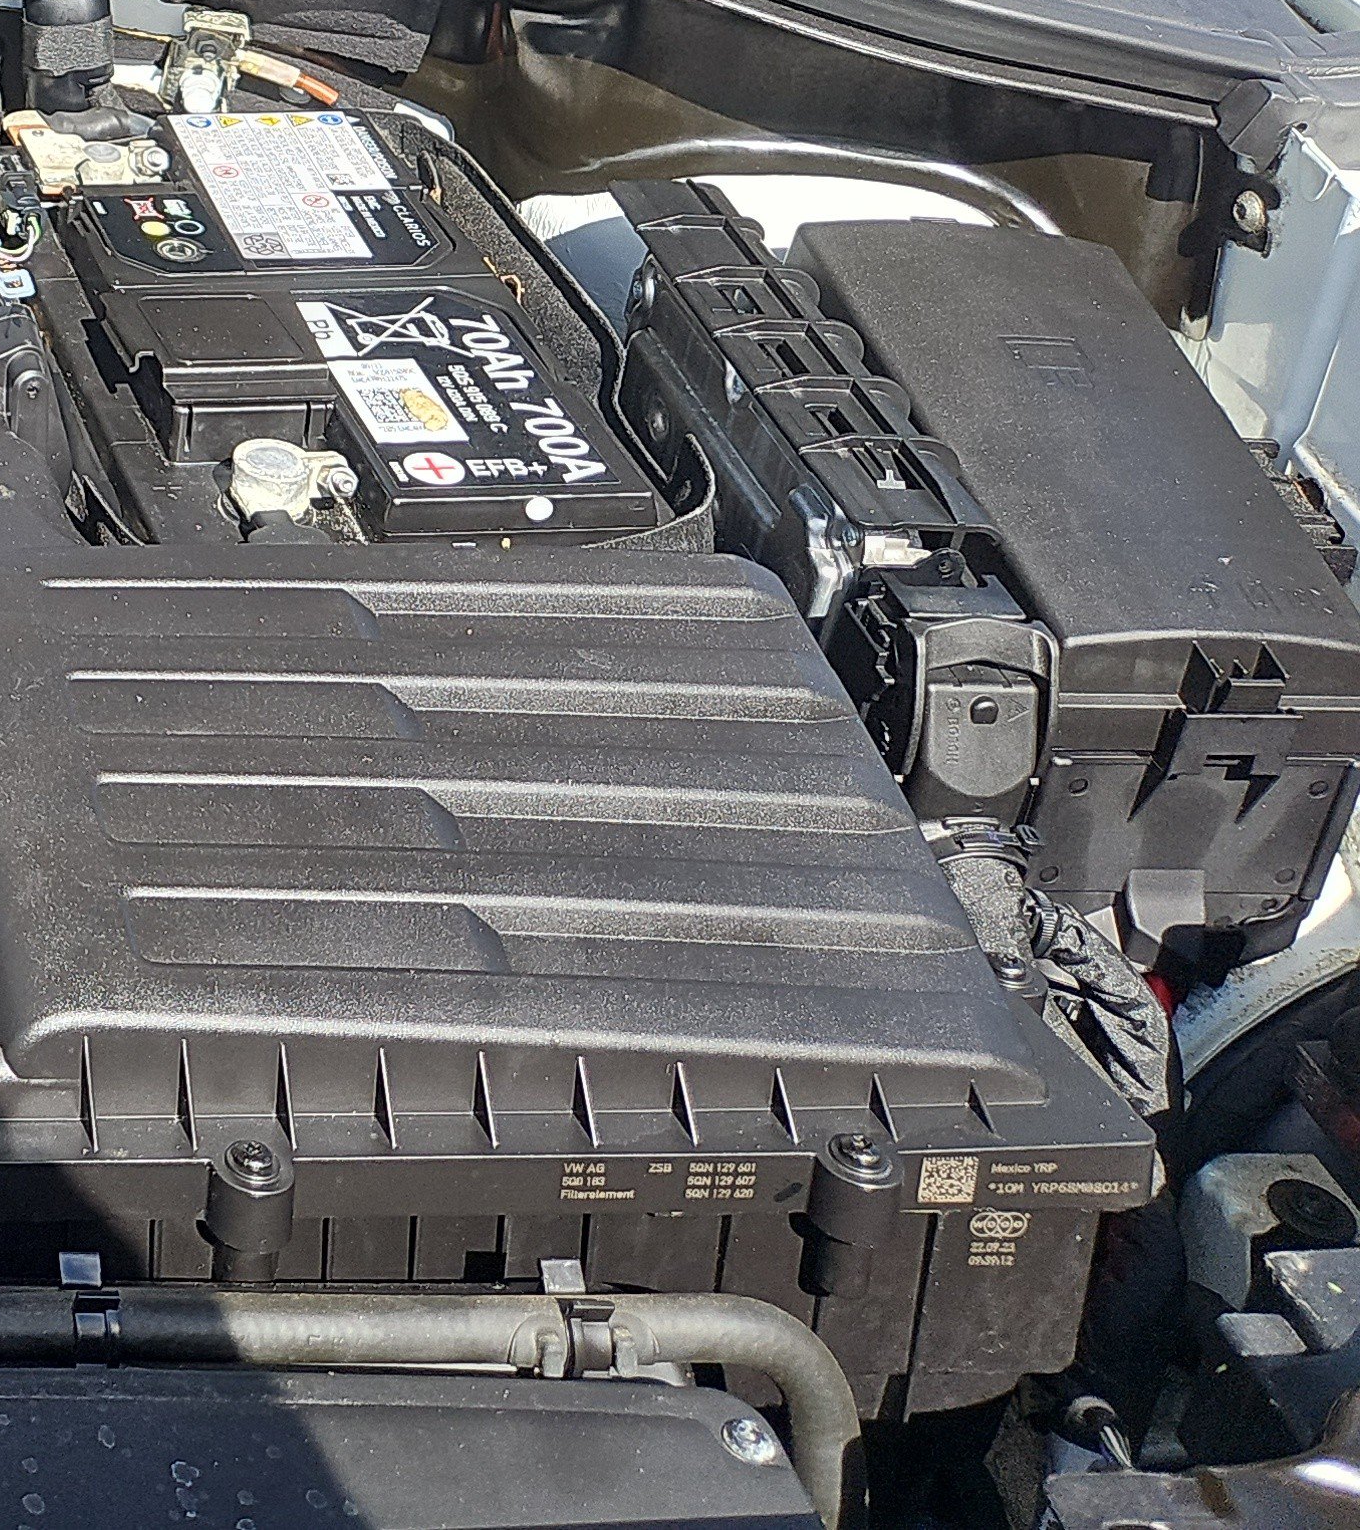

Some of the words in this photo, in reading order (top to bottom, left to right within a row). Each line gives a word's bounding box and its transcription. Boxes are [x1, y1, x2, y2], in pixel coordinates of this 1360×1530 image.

[394, 205, 431, 248] CLARIOS
[307, 320, 334, 339] Pb
[449, 314, 536, 390] 70Ah
[509, 398, 609, 483] 700A
[465, 458, 548, 478] EFB+
[564, 1162, 584, 1174] VW
[586, 1162, 605, 1174] AG
[648, 1163, 673, 1174] ZSB
[716, 1162, 736, 1173] 129
[737, 1162, 757, 1173] 601
[991, 1162, 1032, 1174] Mexico
[1033, 1162, 1058, 1173] YRP
[714, 1175, 734, 1186] 129
[713, 1188, 732, 1199] 129
